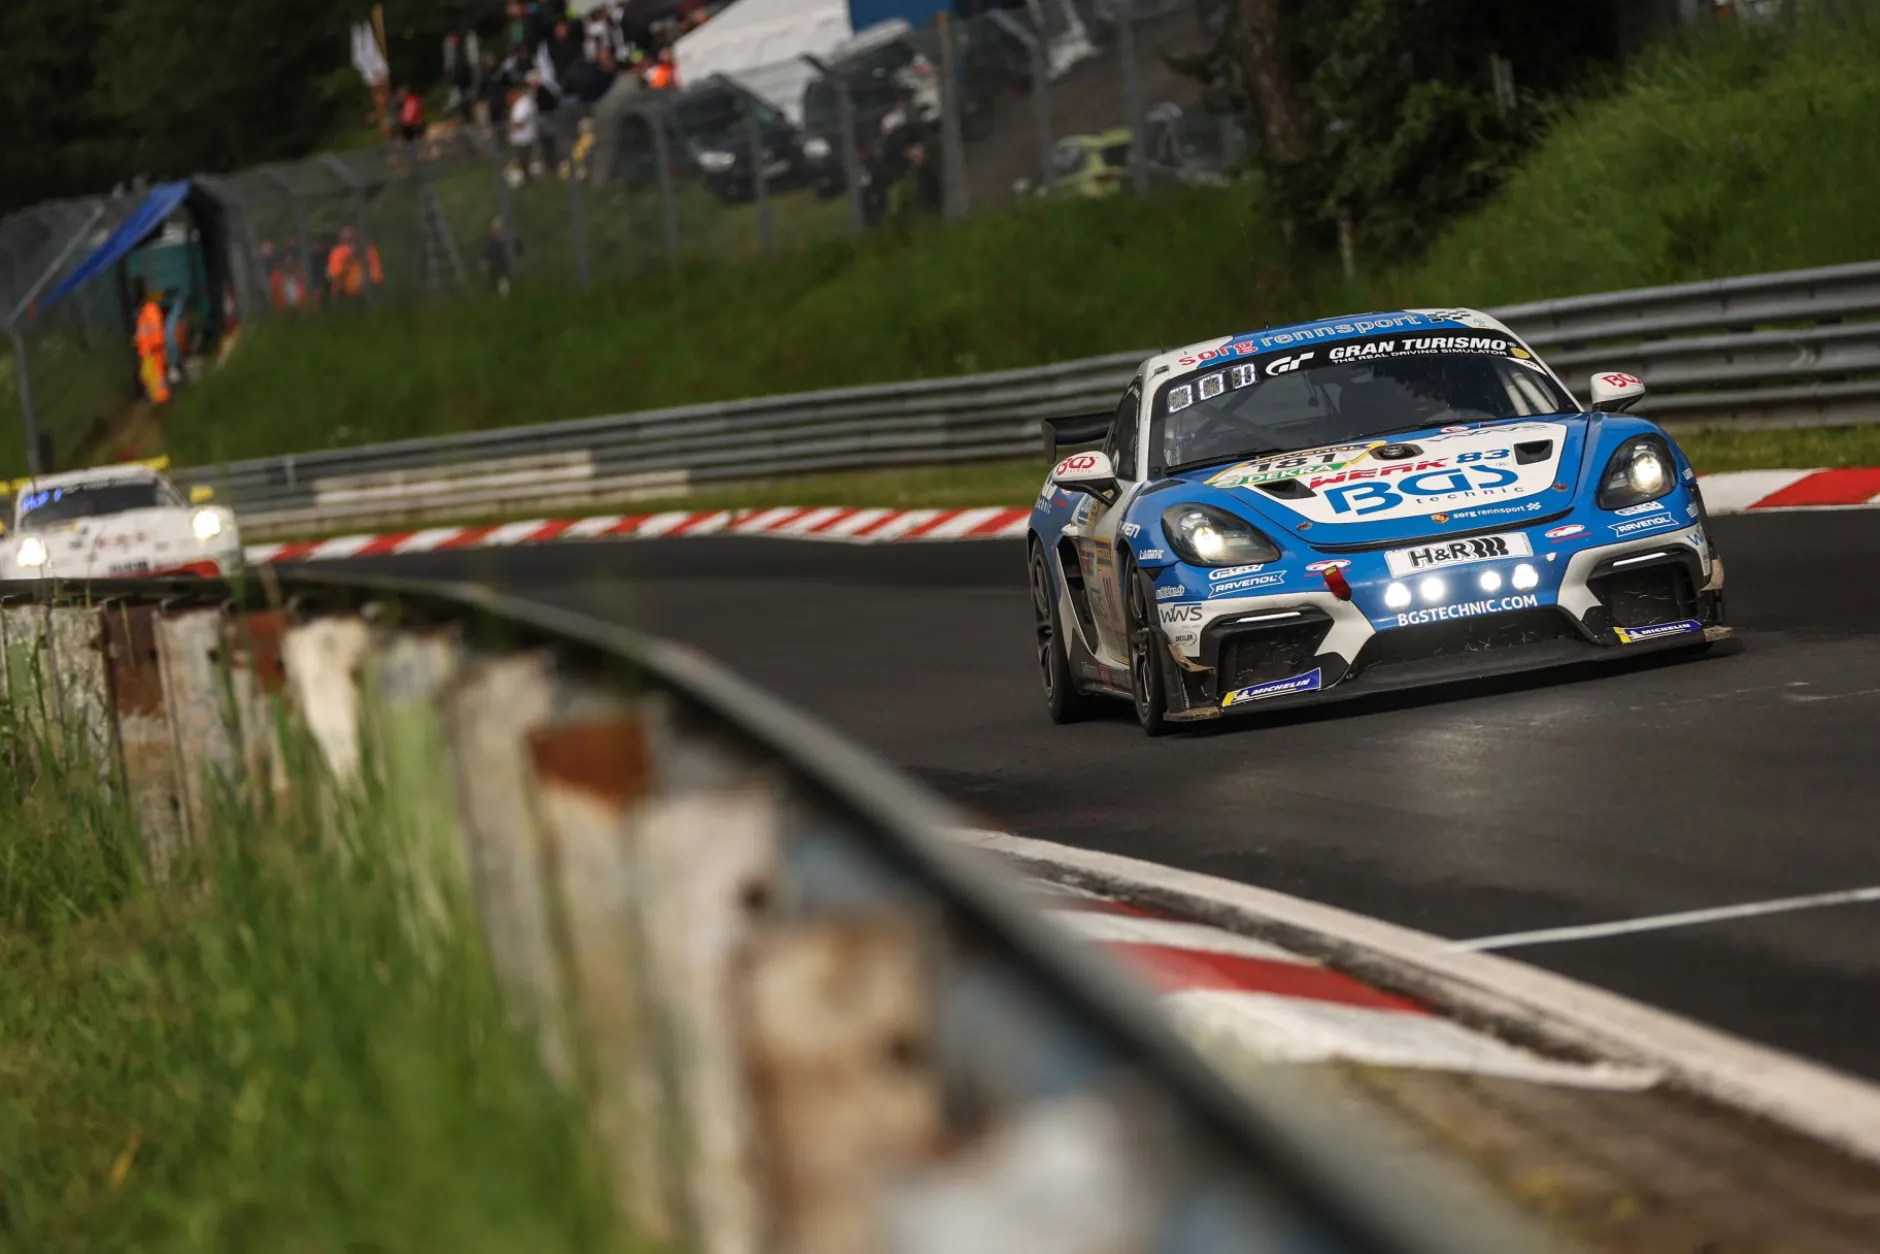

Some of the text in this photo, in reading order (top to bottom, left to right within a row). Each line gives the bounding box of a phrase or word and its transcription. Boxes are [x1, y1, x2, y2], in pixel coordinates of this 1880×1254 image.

[1178, 314, 1422, 366] sorg rennsport
[1329, 336, 1507, 360] GRAN TURISMO
[1358, 352, 1389, 362] REAL
[1390, 348, 1439, 357] DRIVING
[1440, 347, 1507, 356] SIMULATOR
[1251, 453, 1336, 472] 181
[1309, 448, 1511, 489] WERK 83
[1248, 463, 1334, 483] DEKRA
[1323, 464, 1519, 516] BGS
[1415, 485, 1526, 505] technic
[1452, 504, 1526, 519] sorg rennsport
[1616, 515, 1671, 533] RAVENOL
[1409, 542, 1471, 567] H&R
[1215, 574, 1278, 593] RAVENOL
[1397, 594, 1539, 627] BGSTECHNIC.COM
[1641, 622, 1692, 635] MICHELIN
[1250, 678, 1311, 696] MICHELIN
